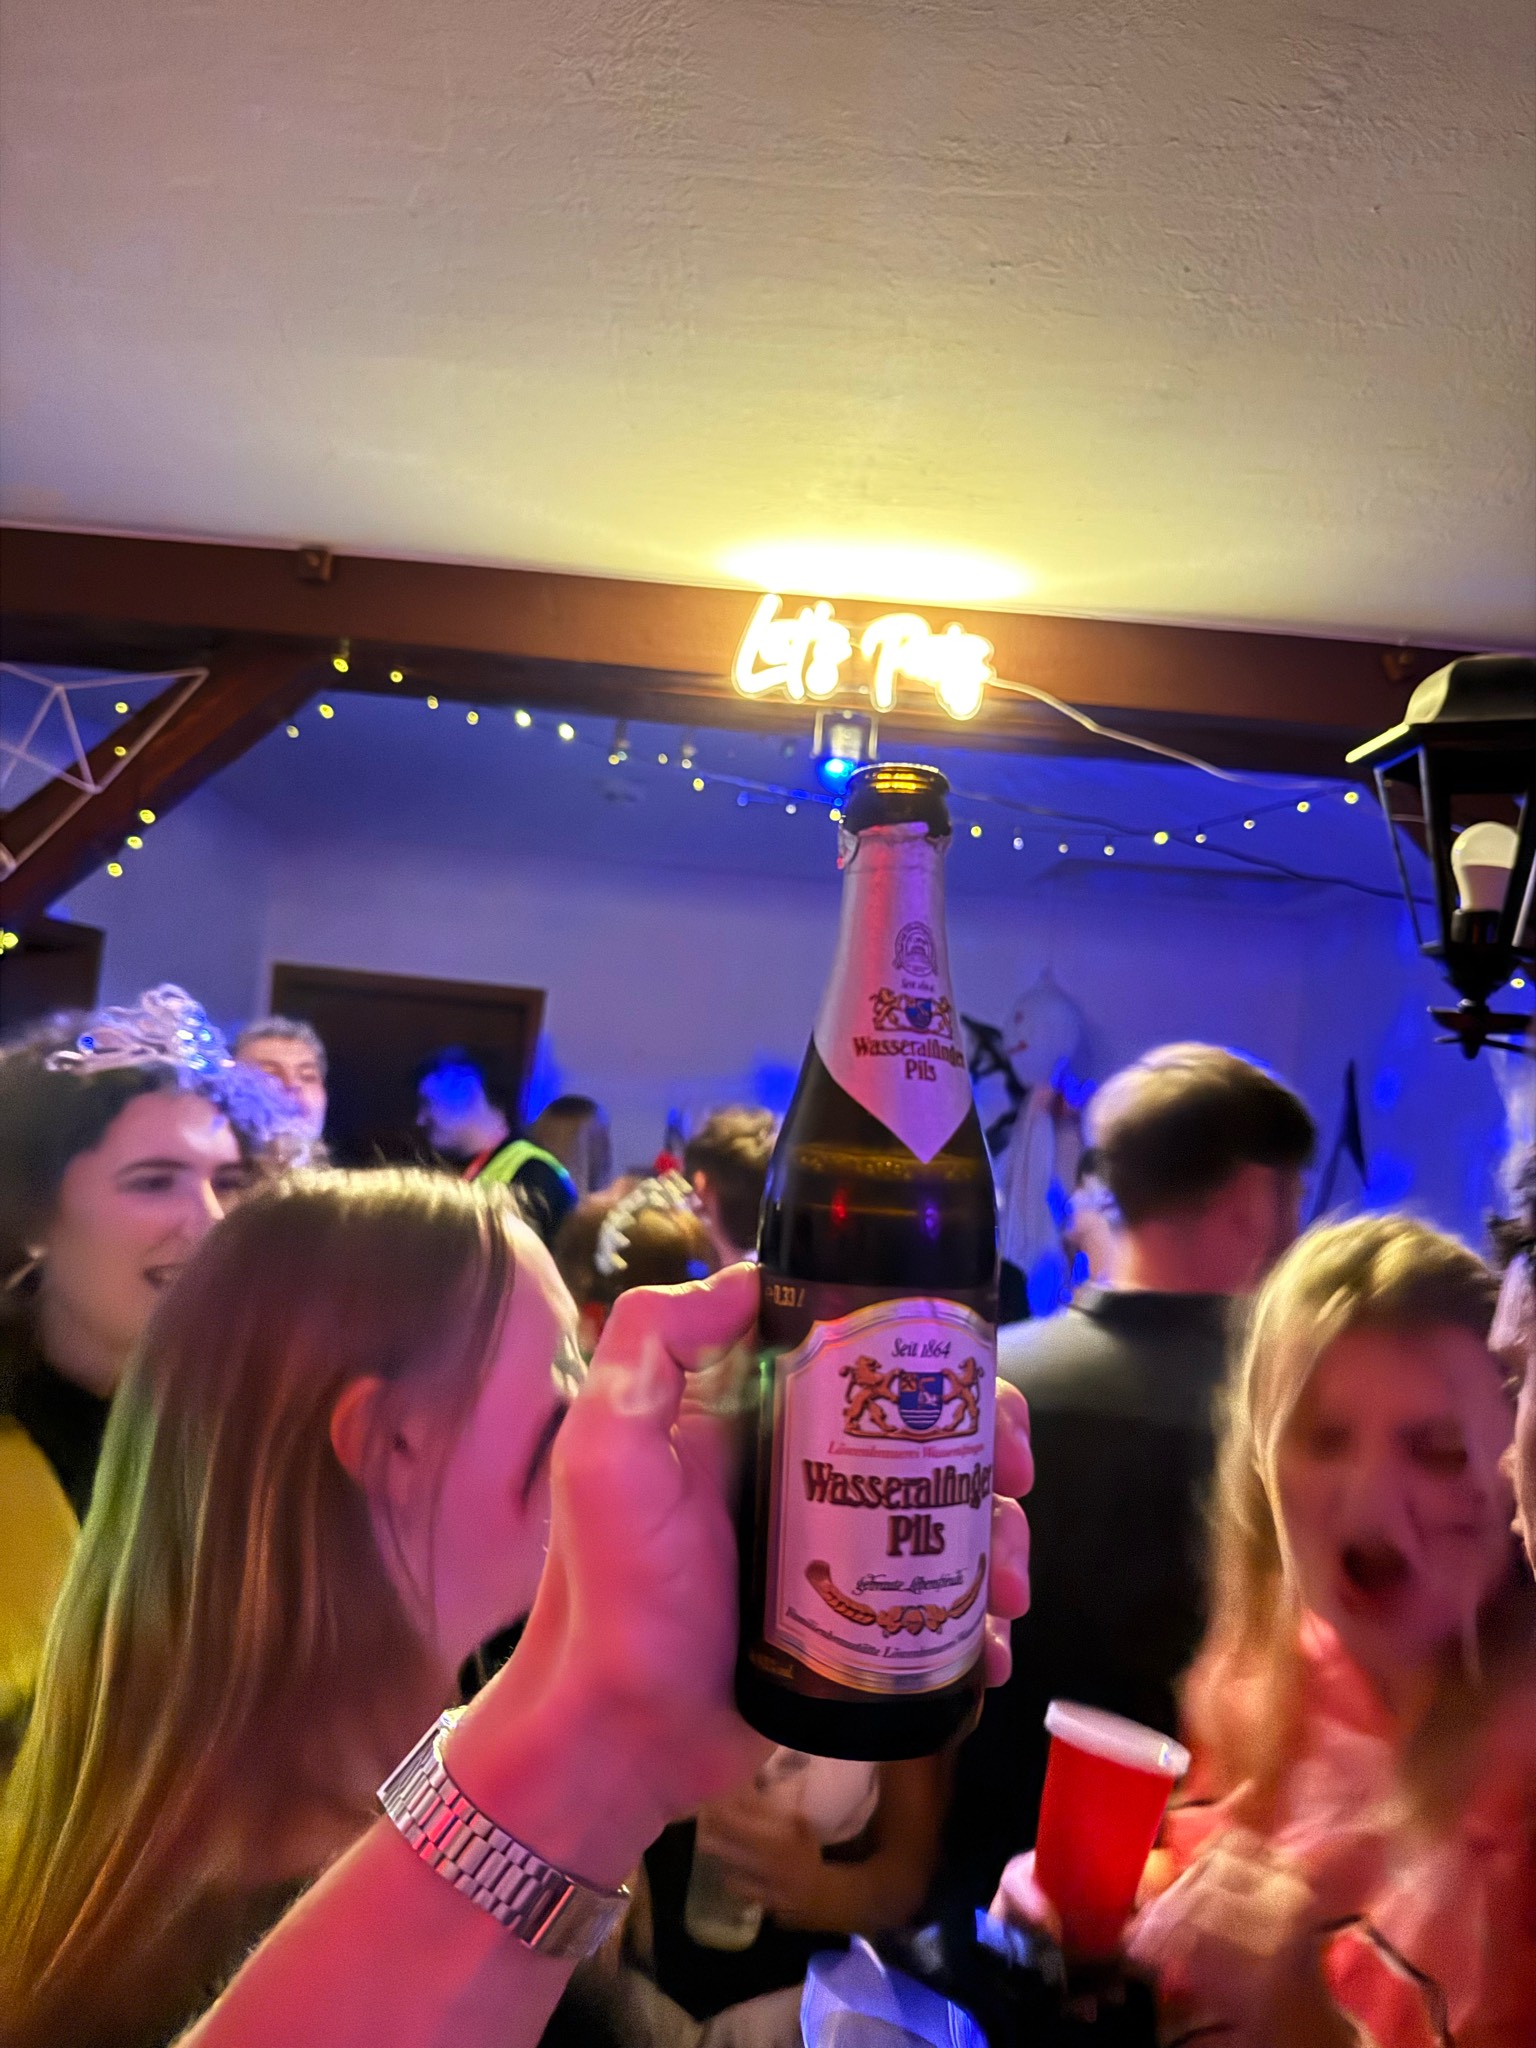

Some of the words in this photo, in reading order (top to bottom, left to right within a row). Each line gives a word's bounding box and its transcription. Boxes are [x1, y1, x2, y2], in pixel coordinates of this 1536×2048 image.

[905, 1058, 938, 1082] Pils
[891, 1337, 918, 1358] Seit
[920, 1338, 952, 1359] 1864
[886, 1513, 946, 1557] Pils
